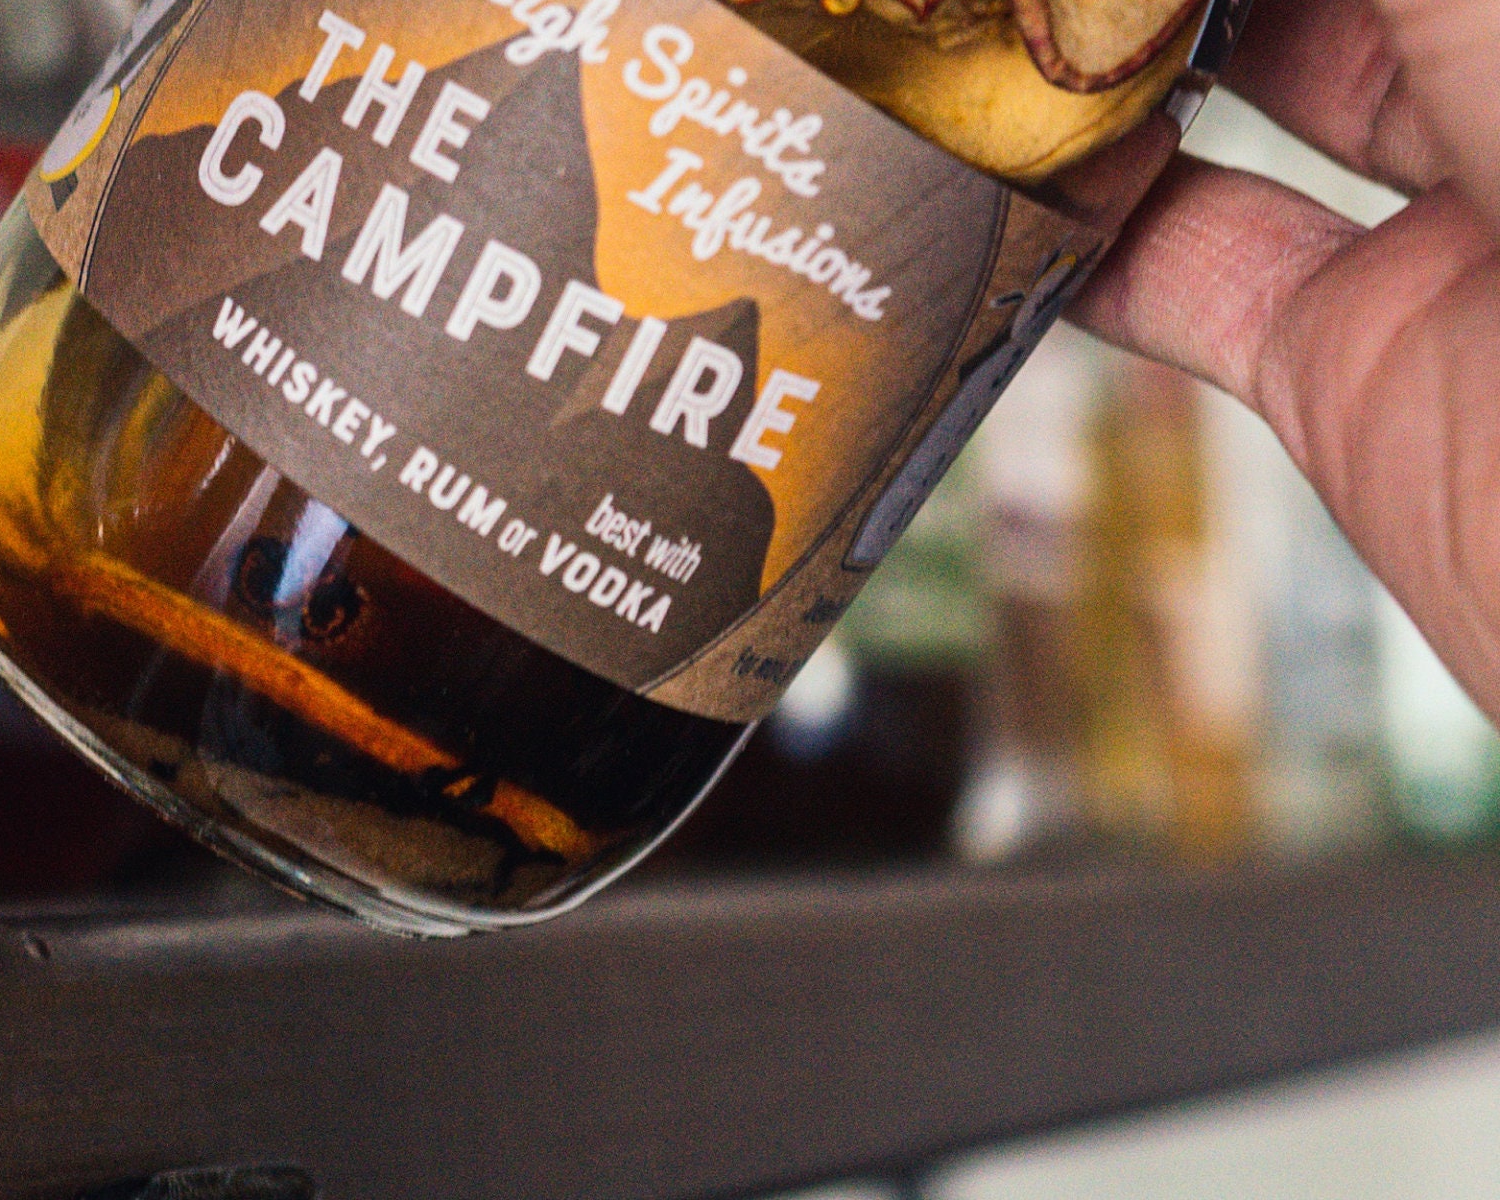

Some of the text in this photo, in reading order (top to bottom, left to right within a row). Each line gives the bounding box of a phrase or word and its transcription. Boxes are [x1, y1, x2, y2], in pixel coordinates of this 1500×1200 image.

[298, 9, 492, 185] THE
[622, 23, 829, 199] Spirits
[198, 88, 822, 471] CAMPFIRE
[627, 147, 893, 322] Infusions
[210, 296, 674, 635] WHISKEY, RUM or VODKA
[583, 492, 703, 585] best with
